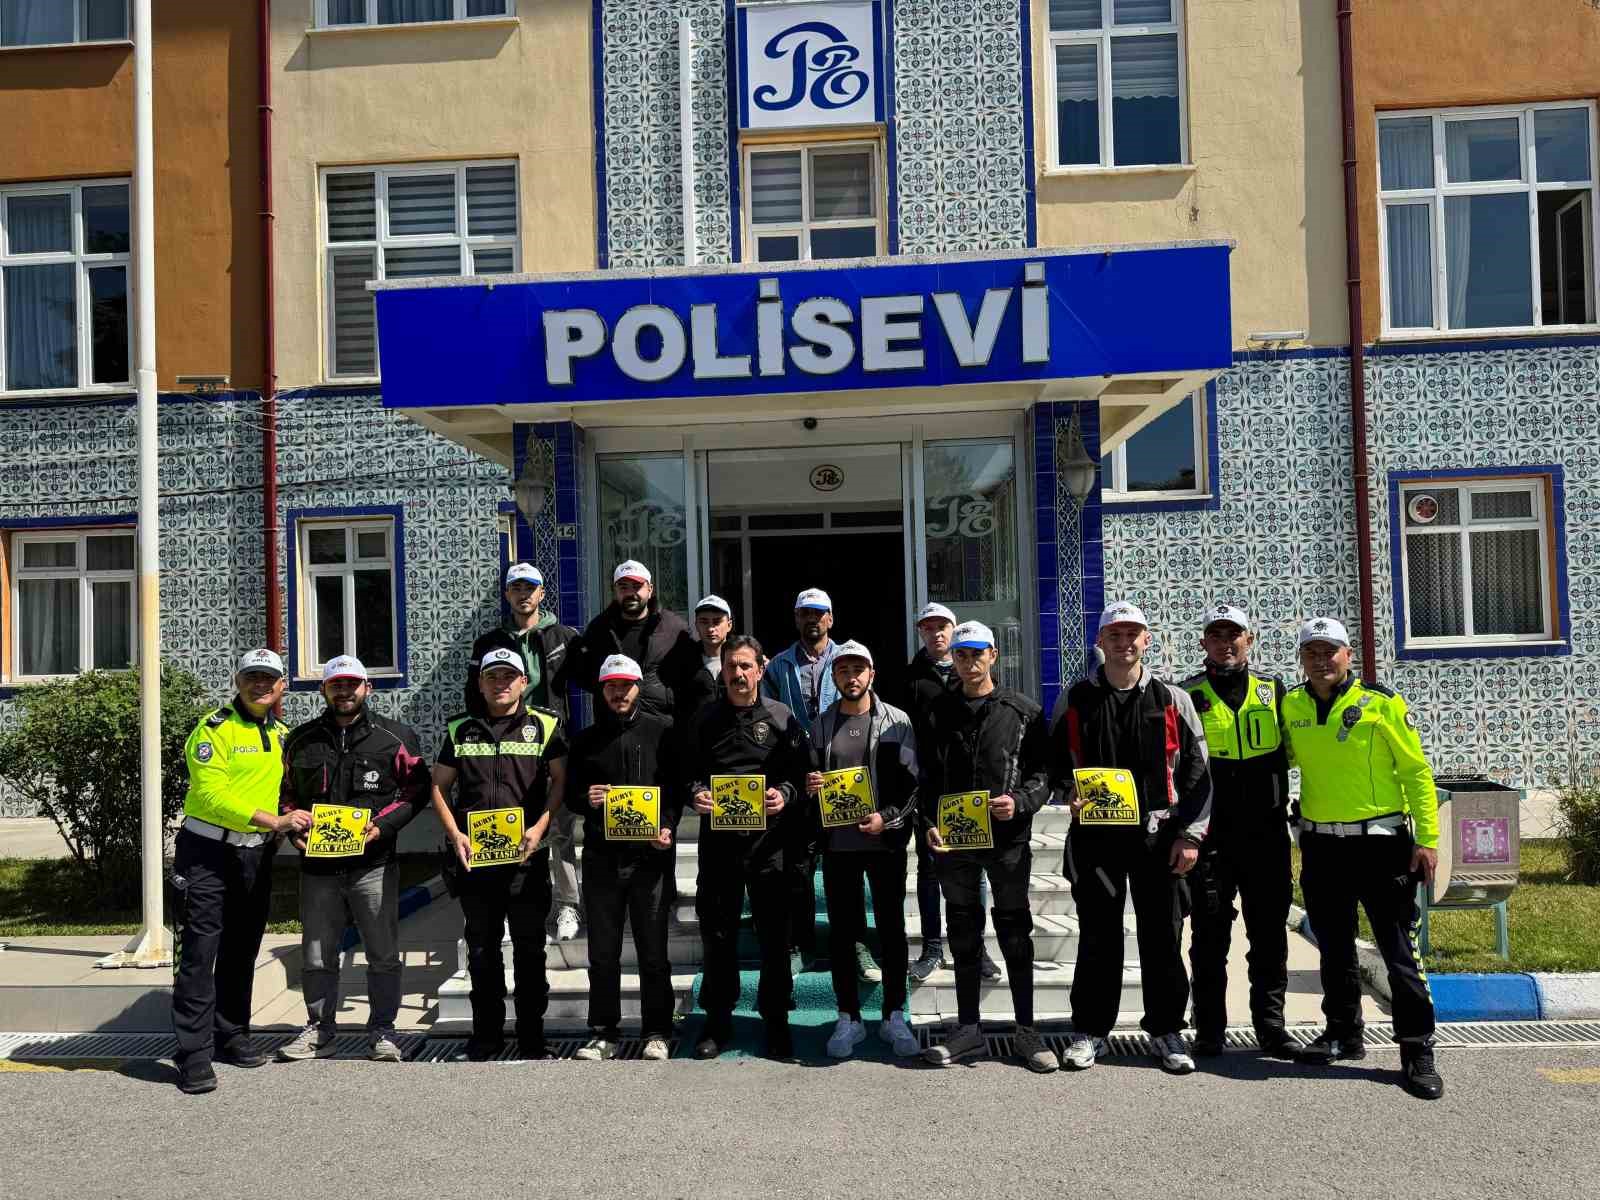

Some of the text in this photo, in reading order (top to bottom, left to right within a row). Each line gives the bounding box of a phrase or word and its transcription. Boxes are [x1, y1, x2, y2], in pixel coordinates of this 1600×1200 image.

[543, 262, 1050, 386] POLİSEVİ
[558, 527, 575, 536] 14
[850, 729, 860, 737] US
[827, 812, 844, 822] CAN
[1085, 810, 1104, 818] CAN
[943, 835, 960, 844] CAN
[474, 850, 491, 861] CAN
